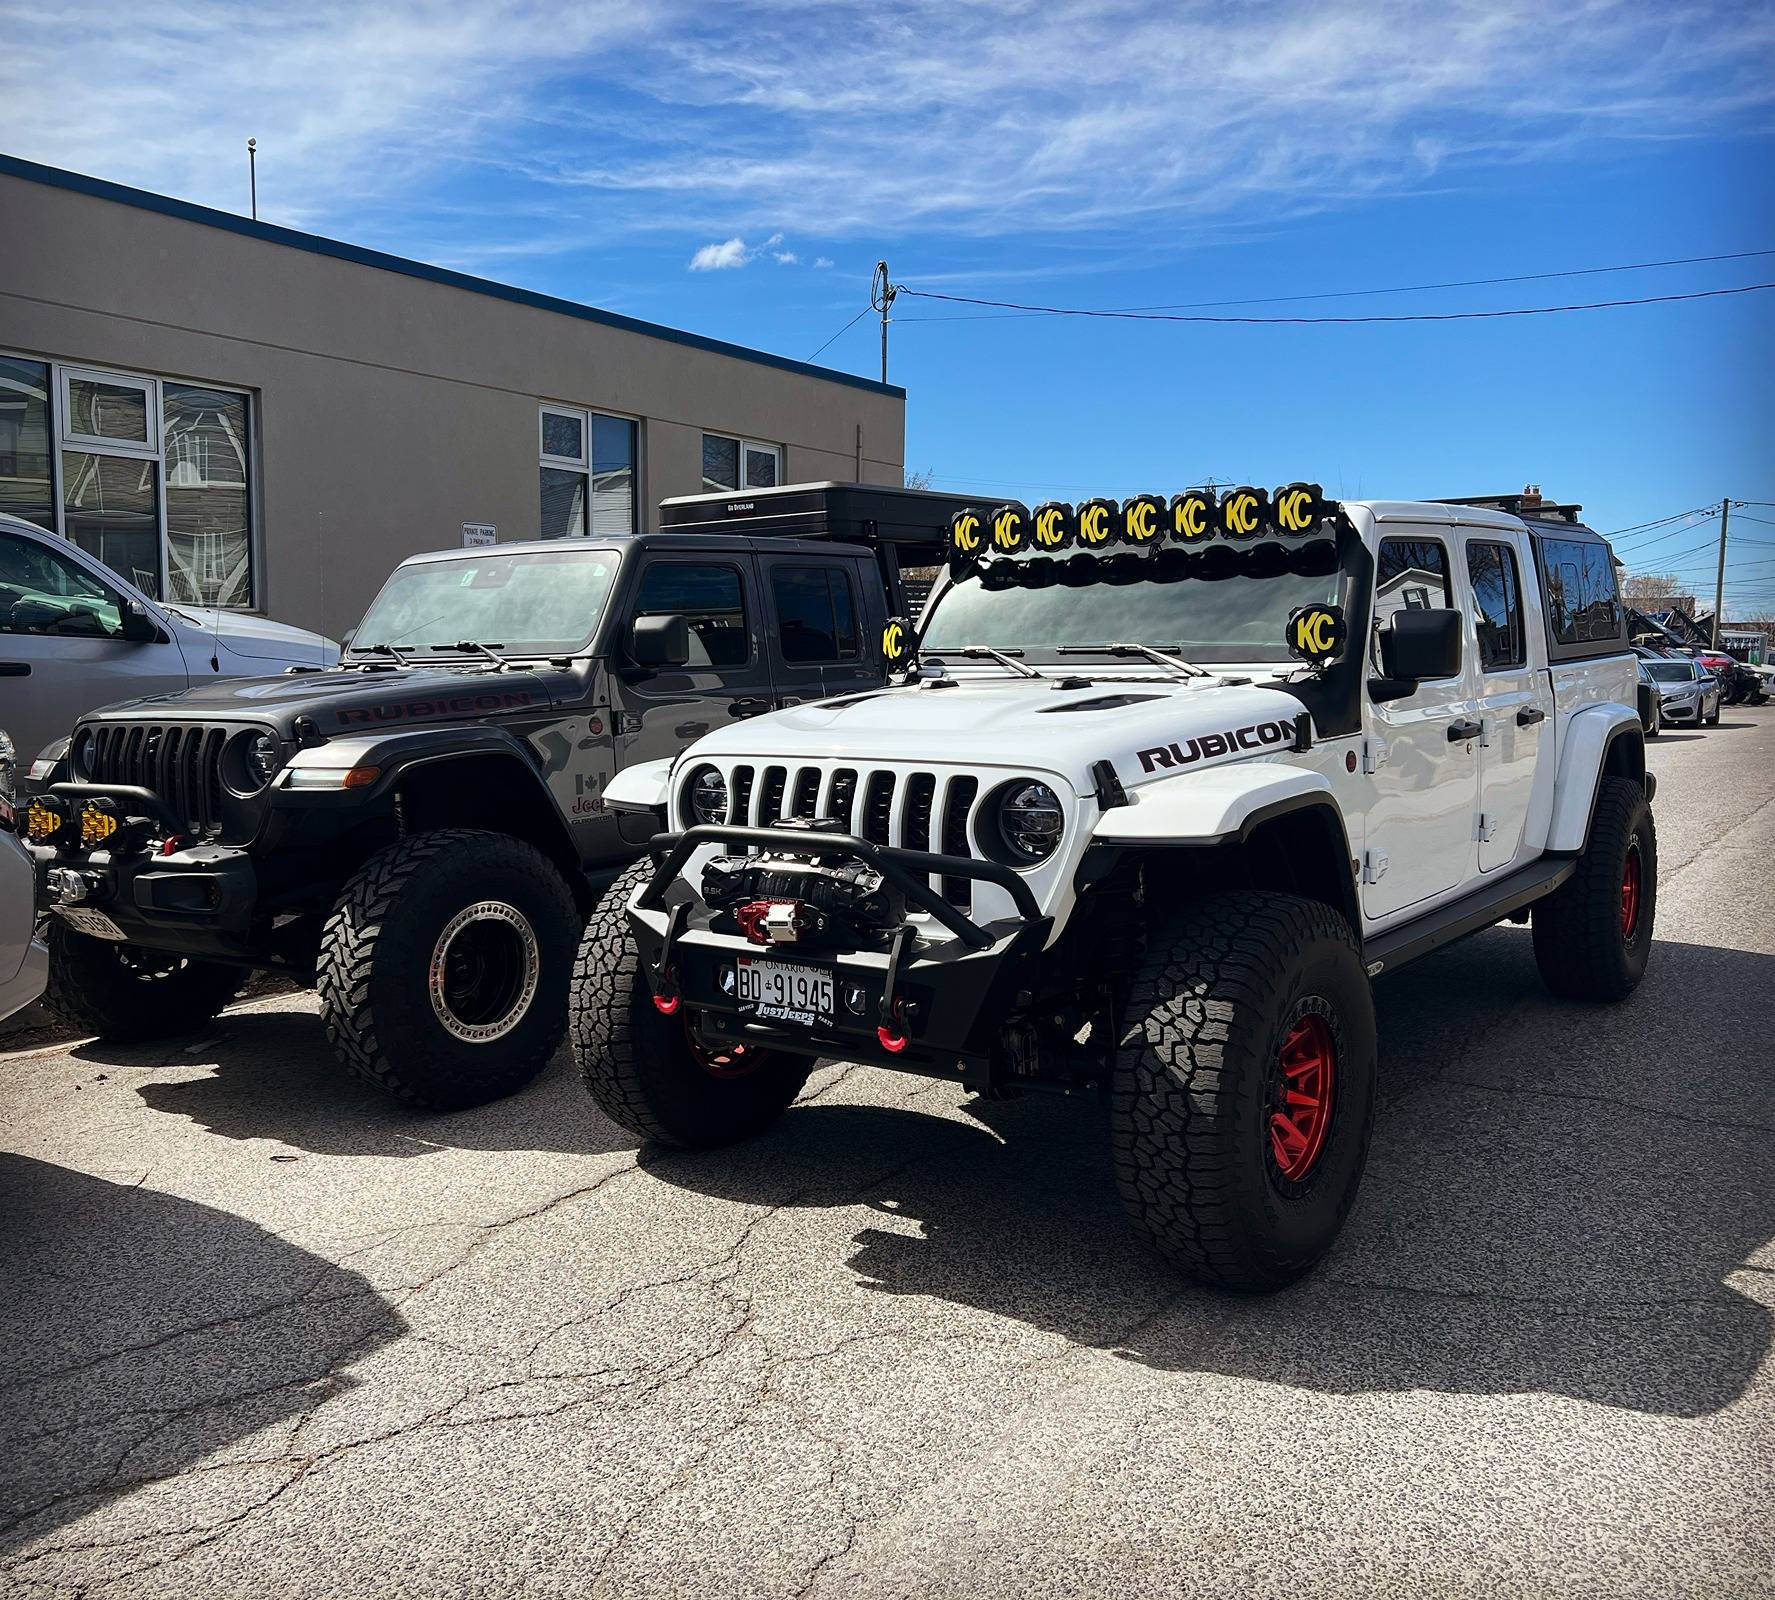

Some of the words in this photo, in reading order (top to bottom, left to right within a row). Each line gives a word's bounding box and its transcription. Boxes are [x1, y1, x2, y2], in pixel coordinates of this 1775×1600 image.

[1036, 509, 1064, 545] KC
[1080, 506, 1109, 543] KC
[1126, 502, 1156, 540] KC
[1175, 498, 1206, 537] KC
[1225, 495, 1258, 534] KC
[1279, 491, 1312, 530] KC
[954, 515, 979, 550] KC
[994, 511, 1021, 548] KC
[882, 623, 903, 658] KC
[1297, 611, 1335, 654] KC
[336, 692, 531, 725] RUBICON
[765, 961, 805, 973] ONTARIO
[740, 968, 761, 1001] BD
[774, 974, 832, 1013] 91945
